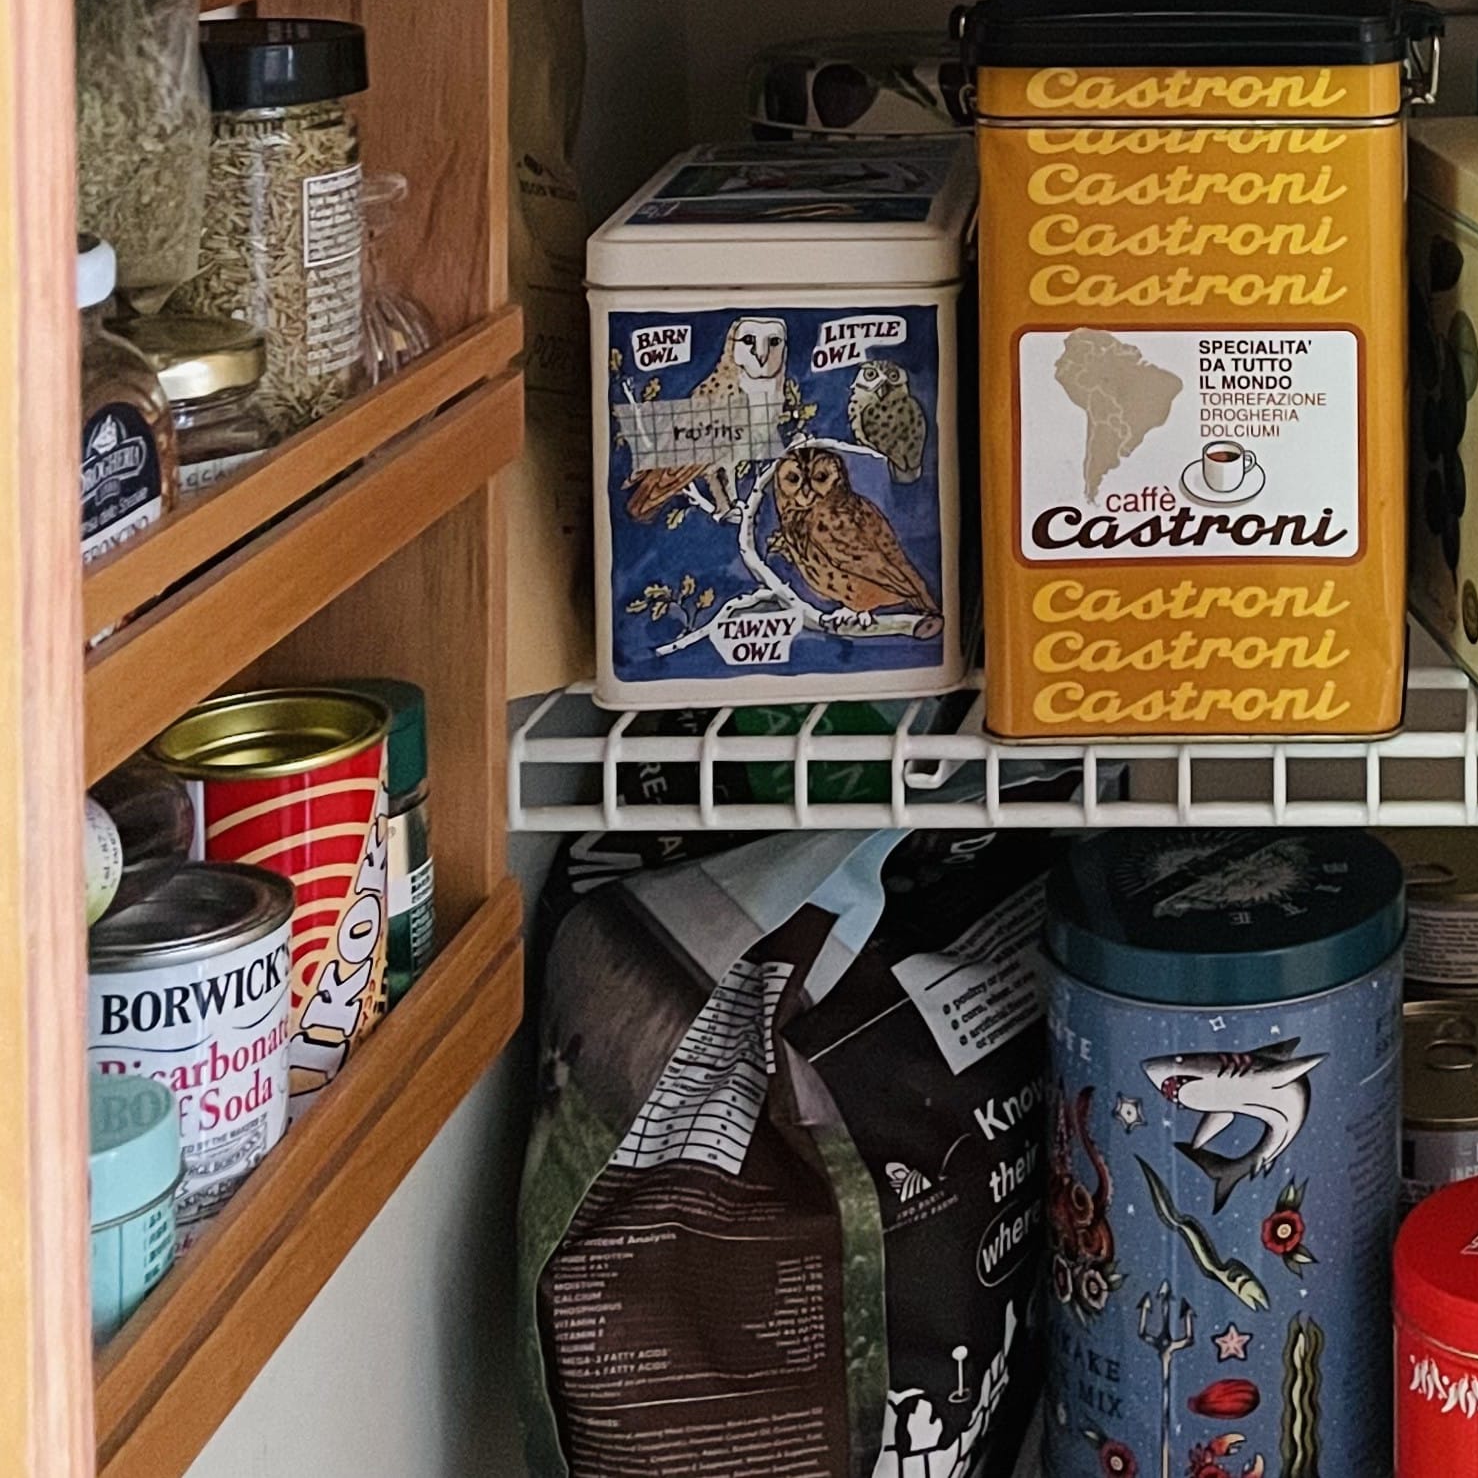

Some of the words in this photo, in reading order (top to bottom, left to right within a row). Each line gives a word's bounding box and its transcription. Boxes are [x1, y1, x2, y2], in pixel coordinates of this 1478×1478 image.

[1025, 67, 1347, 110] Castroni
[1028, 163, 1347, 206] Castroni
[1028, 214, 1348, 257] Castroni
[1028, 265, 1348, 307] Castroni
[637, 327, 689, 350] BARN
[823, 320, 901, 344] LITTLE
[640, 347, 679, 367] OWL
[813, 344, 861, 369] OWL
[1199, 340, 1312, 354] SPECIALITA'
[1200, 358, 1225, 372] DA
[1231, 358, 1293, 372] TUTTO
[1200, 375, 1215, 389] IL
[1222, 375, 1292, 389] MONDO
[1200, 393, 1327, 406] TORREFAZIONE
[1200, 408, 1299, 422] DROGHERIA
[672, 422, 743, 442] raisins
[1201, 424, 1280, 437] DOLCIUMI
[1105, 487, 1176, 513] caffè
[1030, 505, 1348, 550] Castroni
[1032, 580, 1351, 622] Castroni
[718, 617, 795, 643] TAWNY
[732, 640, 782, 662] OWL
[1032, 629, 1351, 673] Castroni
[1032, 681, 1351, 723] Castroni
[101, 941, 289, 1035] BORWICK'
[953, 982, 987, 1010] poultry
[199, 1069, 272, 1131] Soda
[989, 1139, 1038, 1203] their
[627, 1232, 677, 1244] Analysis
[554, 1292, 602, 1303] CALCIUM
